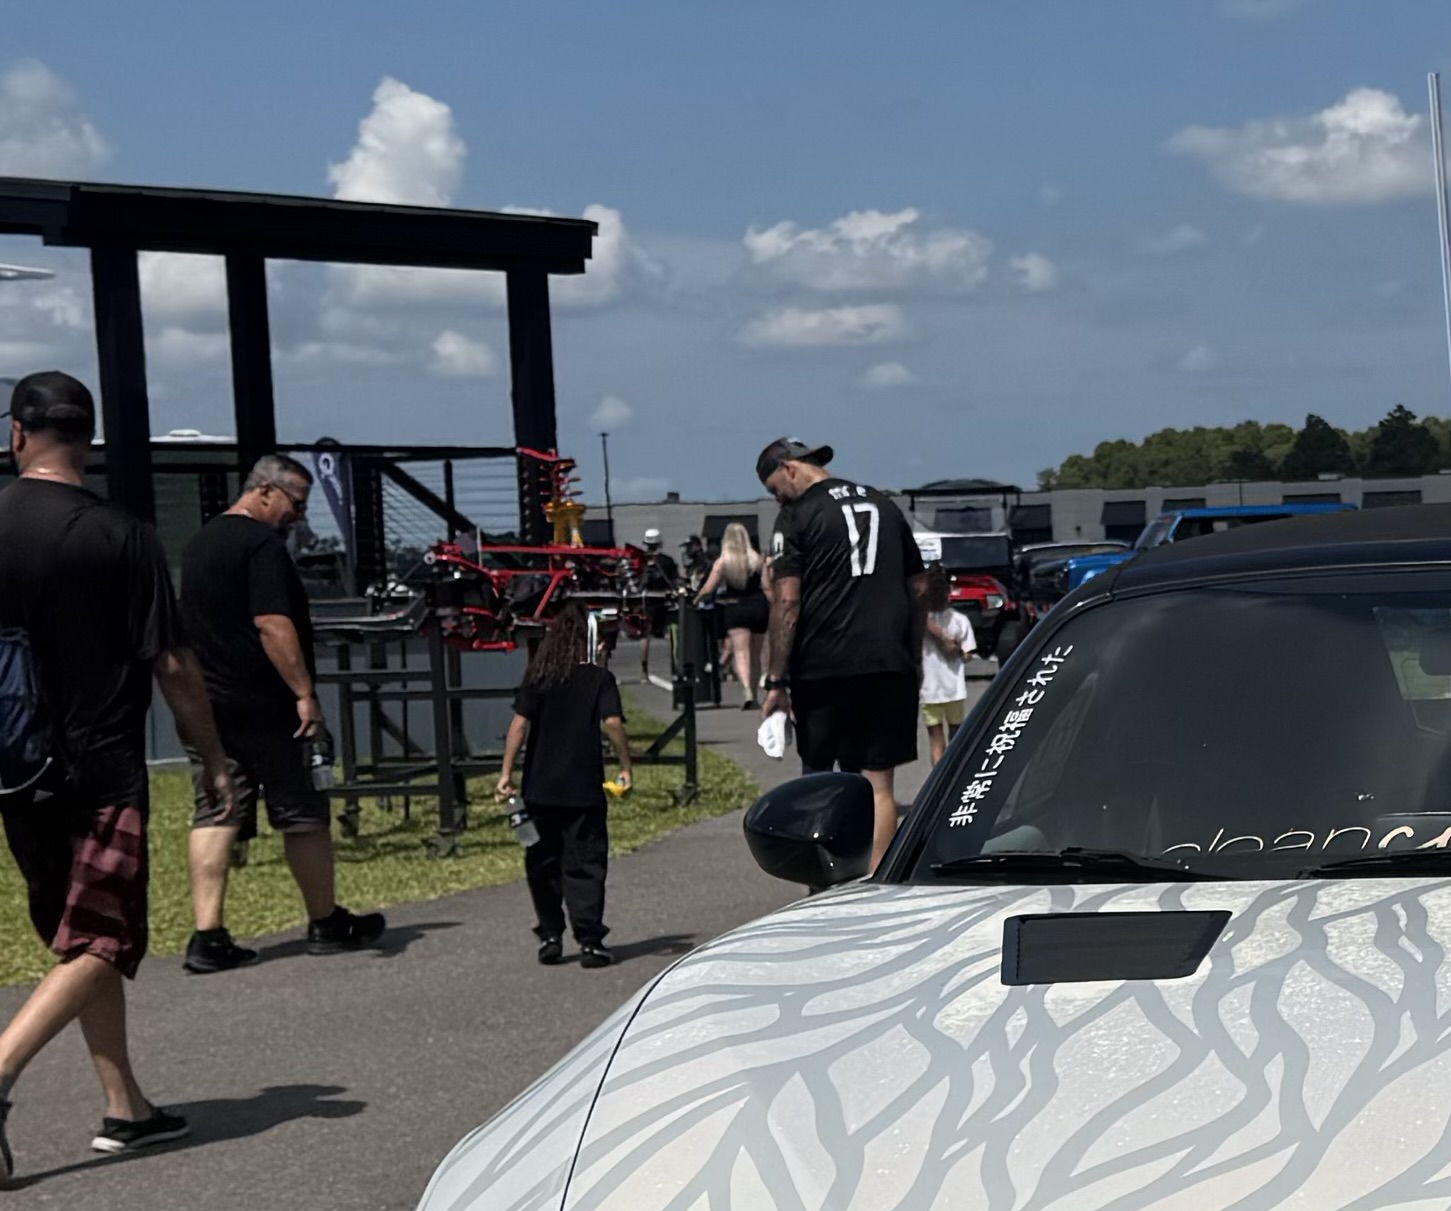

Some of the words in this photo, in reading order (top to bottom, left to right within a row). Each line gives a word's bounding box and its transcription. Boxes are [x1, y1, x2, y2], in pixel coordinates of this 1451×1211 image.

[841, 502, 880, 577] 17
[948, 644, 1074, 827] 非常に祝福された
